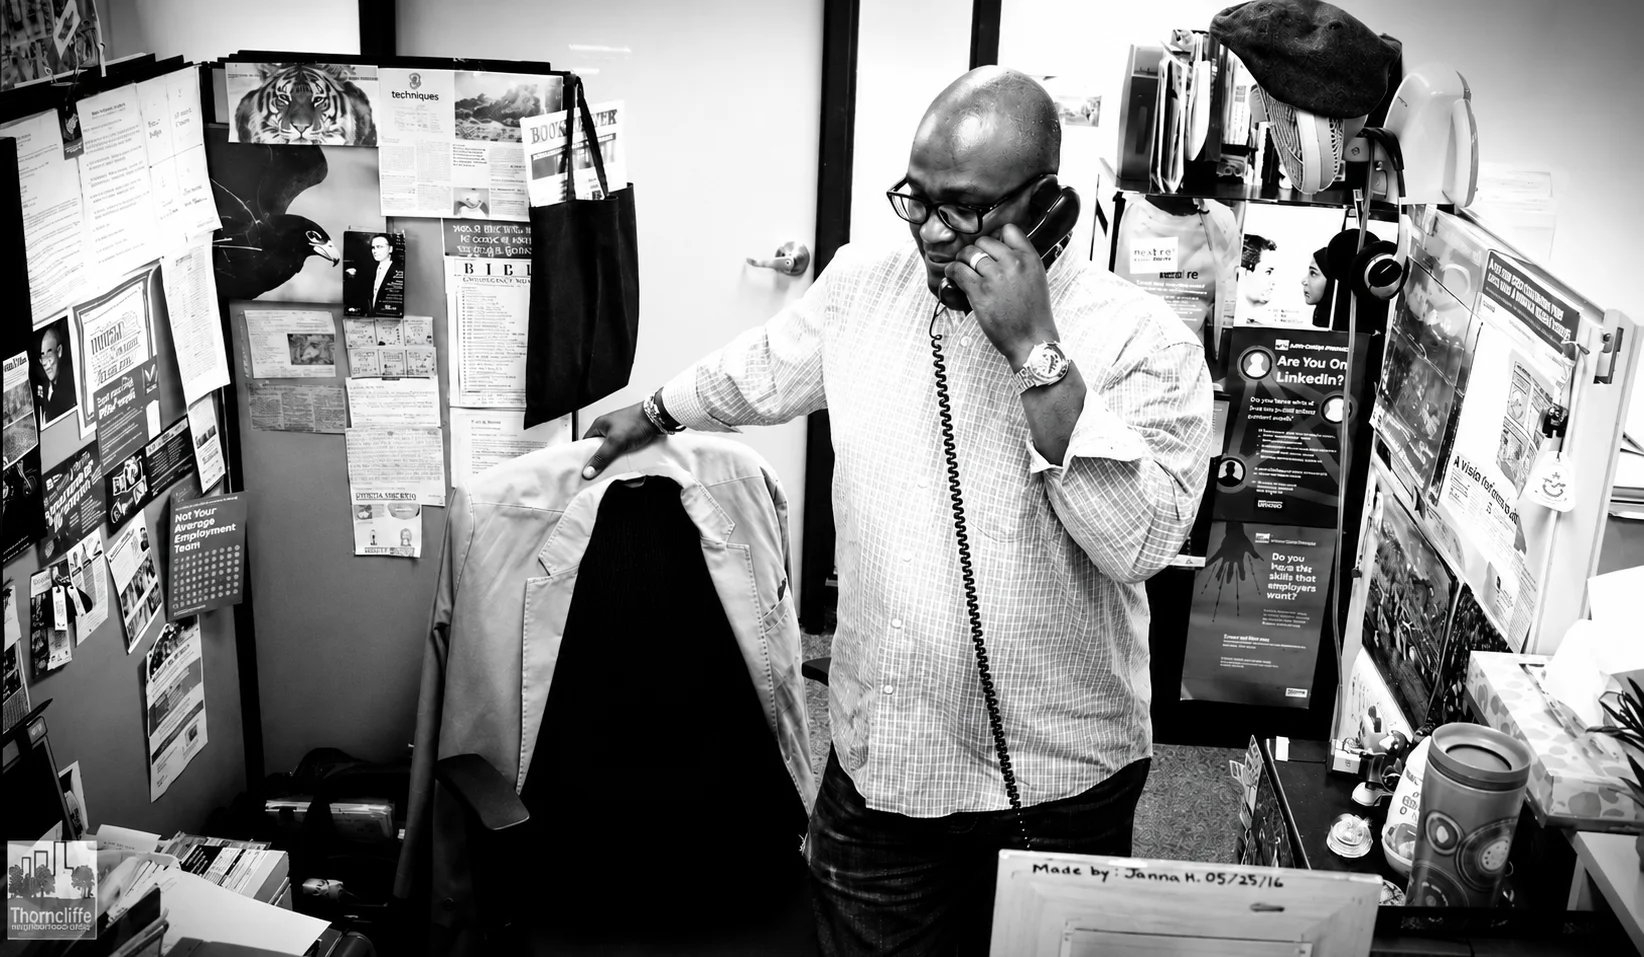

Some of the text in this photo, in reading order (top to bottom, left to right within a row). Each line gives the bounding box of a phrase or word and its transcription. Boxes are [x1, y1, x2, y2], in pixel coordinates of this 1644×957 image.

[391, 90, 439, 102] techniques
[1277, 355, 1348, 370] Are You On
[1276, 371, 1345, 386] LinkedIn?
[1454, 456, 1460, 468] A
[175, 508, 217, 523] Not Your
[174, 518, 215, 533] Average
[174, 523, 236, 543] Employment
[174, 542, 200, 553] Team
[1272, 552, 1305, 564] Do you
[1269, 571, 1317, 583] skills that
[1267, 582, 1317, 594] employers
[1266, 591, 1298, 601] want?
[1032, 863, 1082, 876] Made
[1124, 867, 1181, 883] Janna
[1185, 872, 1201, 884] H.
[1205, 871, 1285, 889] 05/25/16
